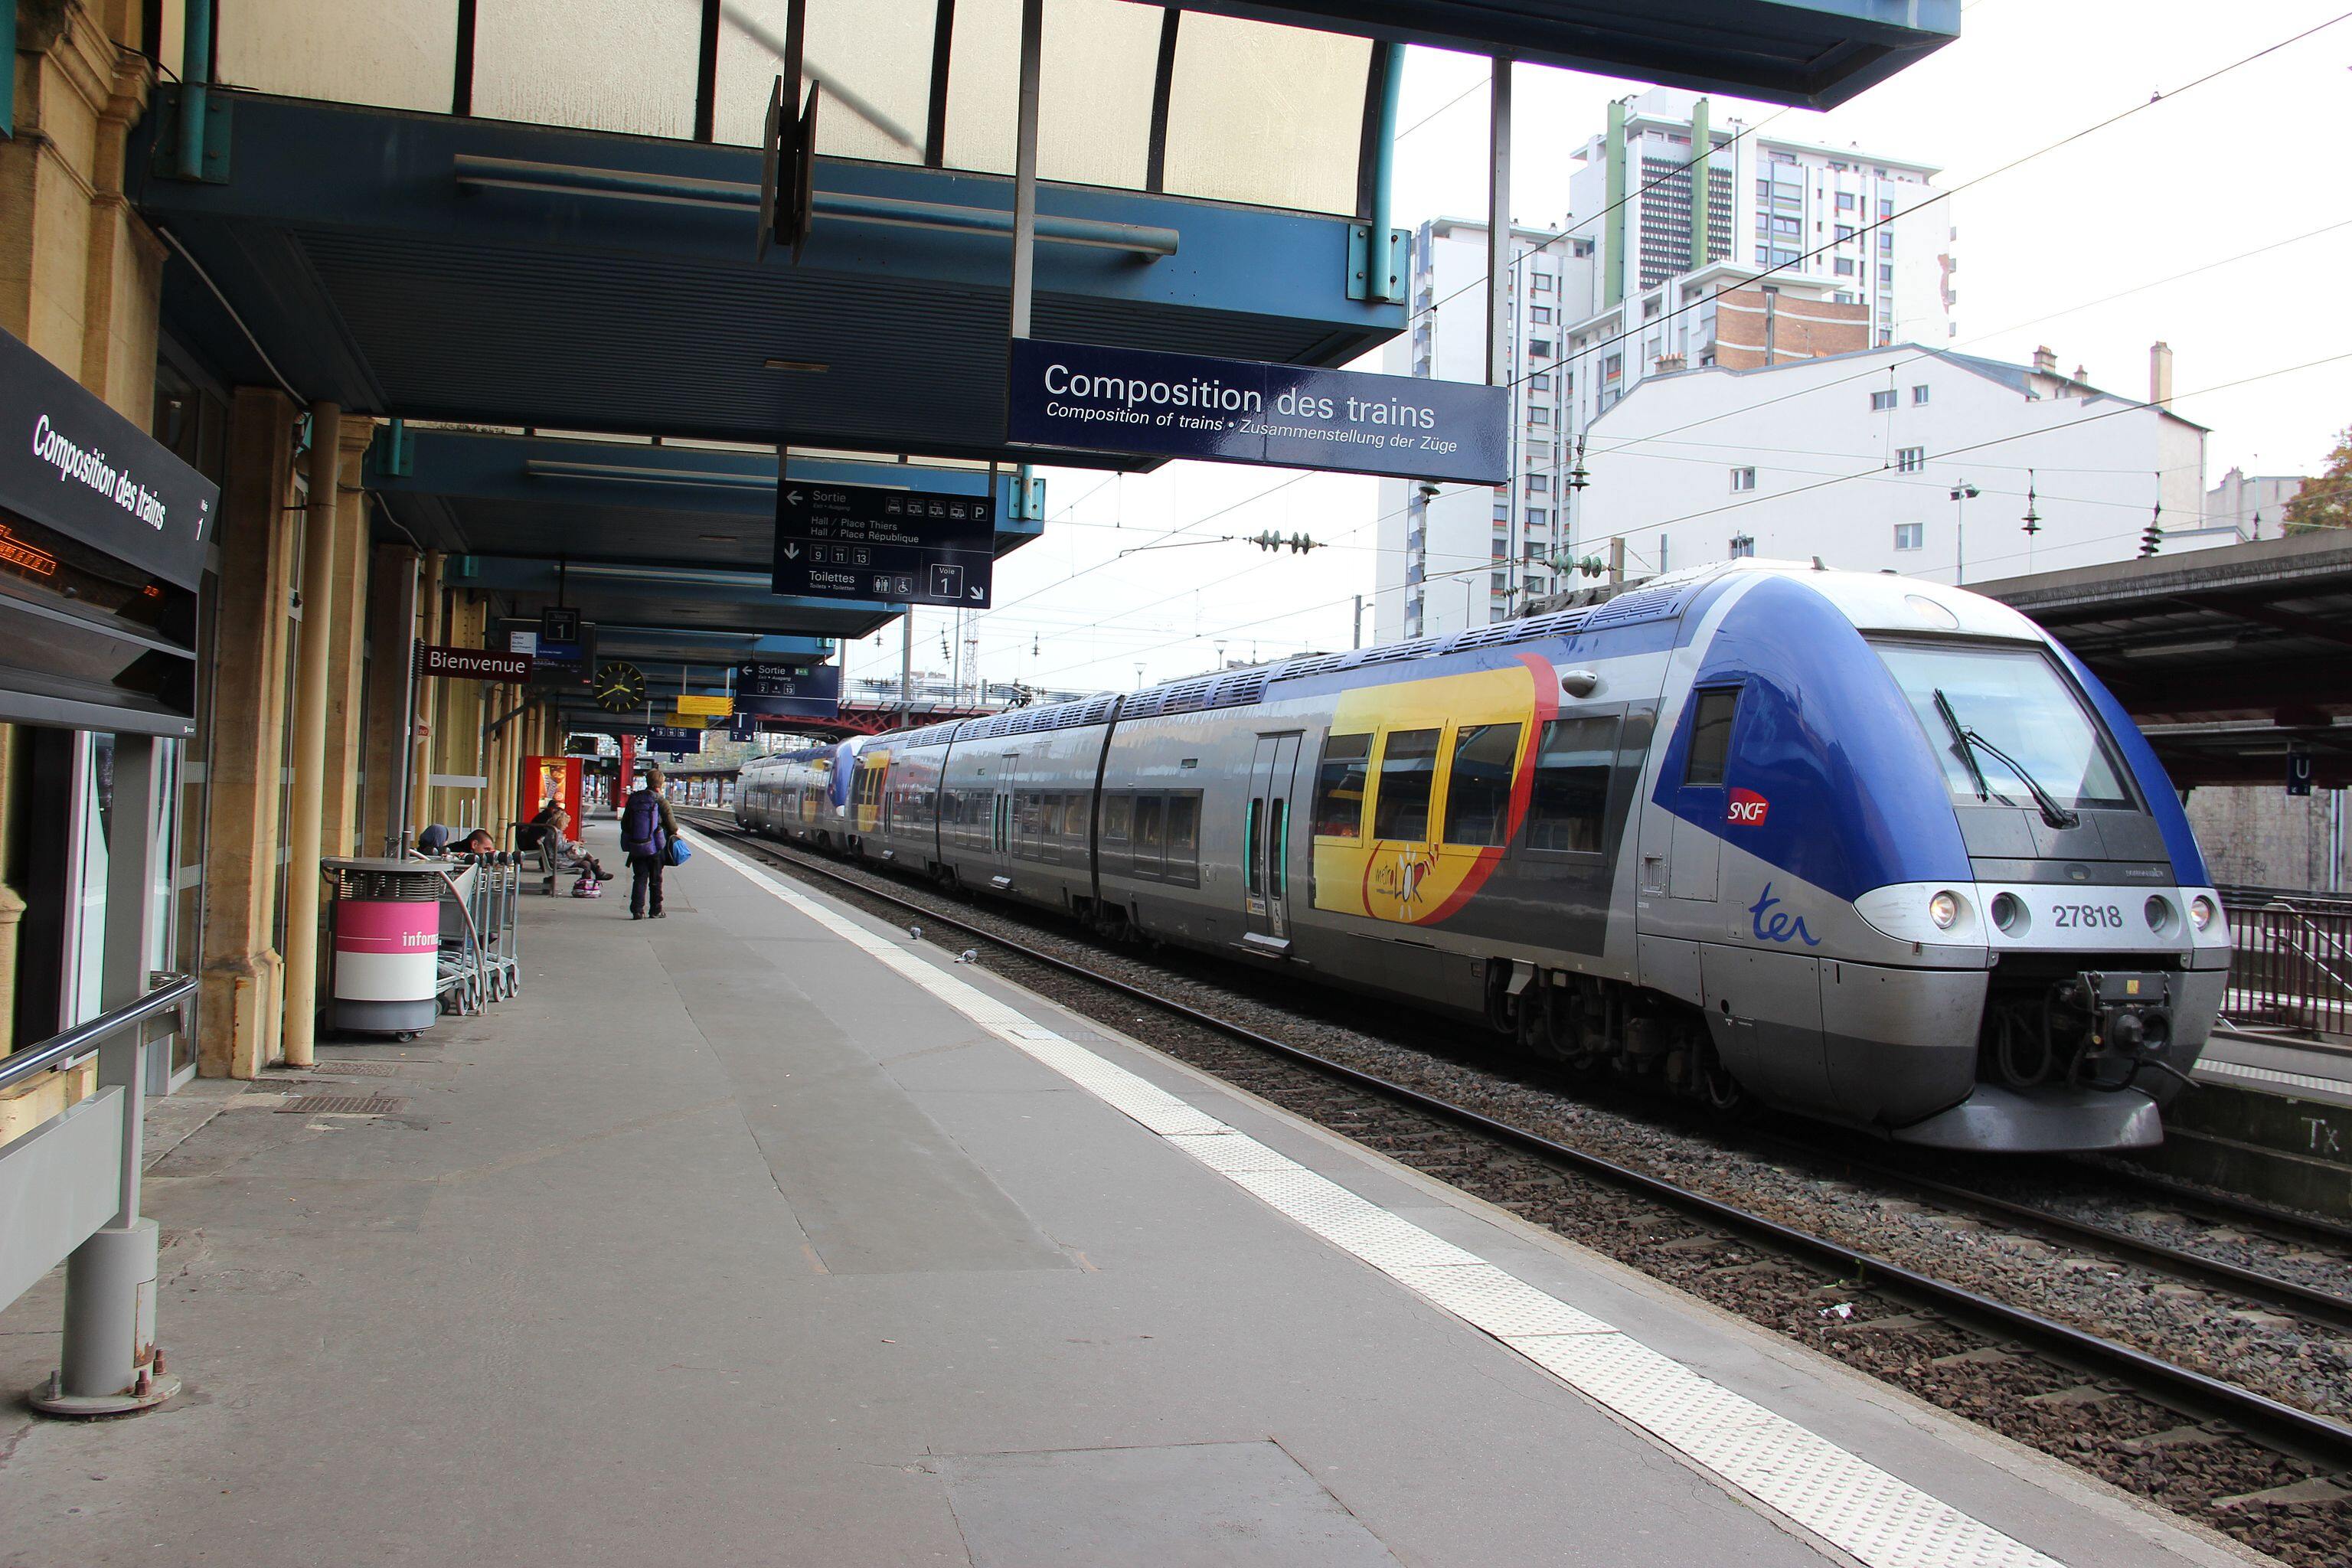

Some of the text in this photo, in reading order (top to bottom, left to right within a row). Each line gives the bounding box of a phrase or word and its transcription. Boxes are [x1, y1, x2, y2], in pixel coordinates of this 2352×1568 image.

[1045, 364, 1435, 429] Composition des trains
[1046, 402, 1223, 431] Composition of trains
[1240, 419, 1457, 455] Zusammenstellung der Züge
[34, 413, 166, 531] Composition des trains
[813, 490, 847, 502] Sortie
[975, 507, 985, 518] P
[196, 518, 204, 541] 1
[812, 516, 828, 526] Hall
[841, 518, 865, 528] Place
[870, 521, 898, 531] Thiers
[811, 527, 828, 536] Hall
[841, 529, 865, 539] Place
[868, 531, 920, 544] République
[815, 551, 822, 560] 9
[835, 553, 844, 562] 11
[857, 554, 867, 563] 13
[809, 570, 855, 583] Toilettes
[941, 578, 948, 593] 1
[557, 624, 564, 639] 1
[430, 652, 526, 674] Bienvenue
[759, 665, 786, 675] Sortie
[1728, 802, 1766, 821] SNCF
[1749, 882, 1821, 946] ter
[2052, 905, 2122, 928] 27818
